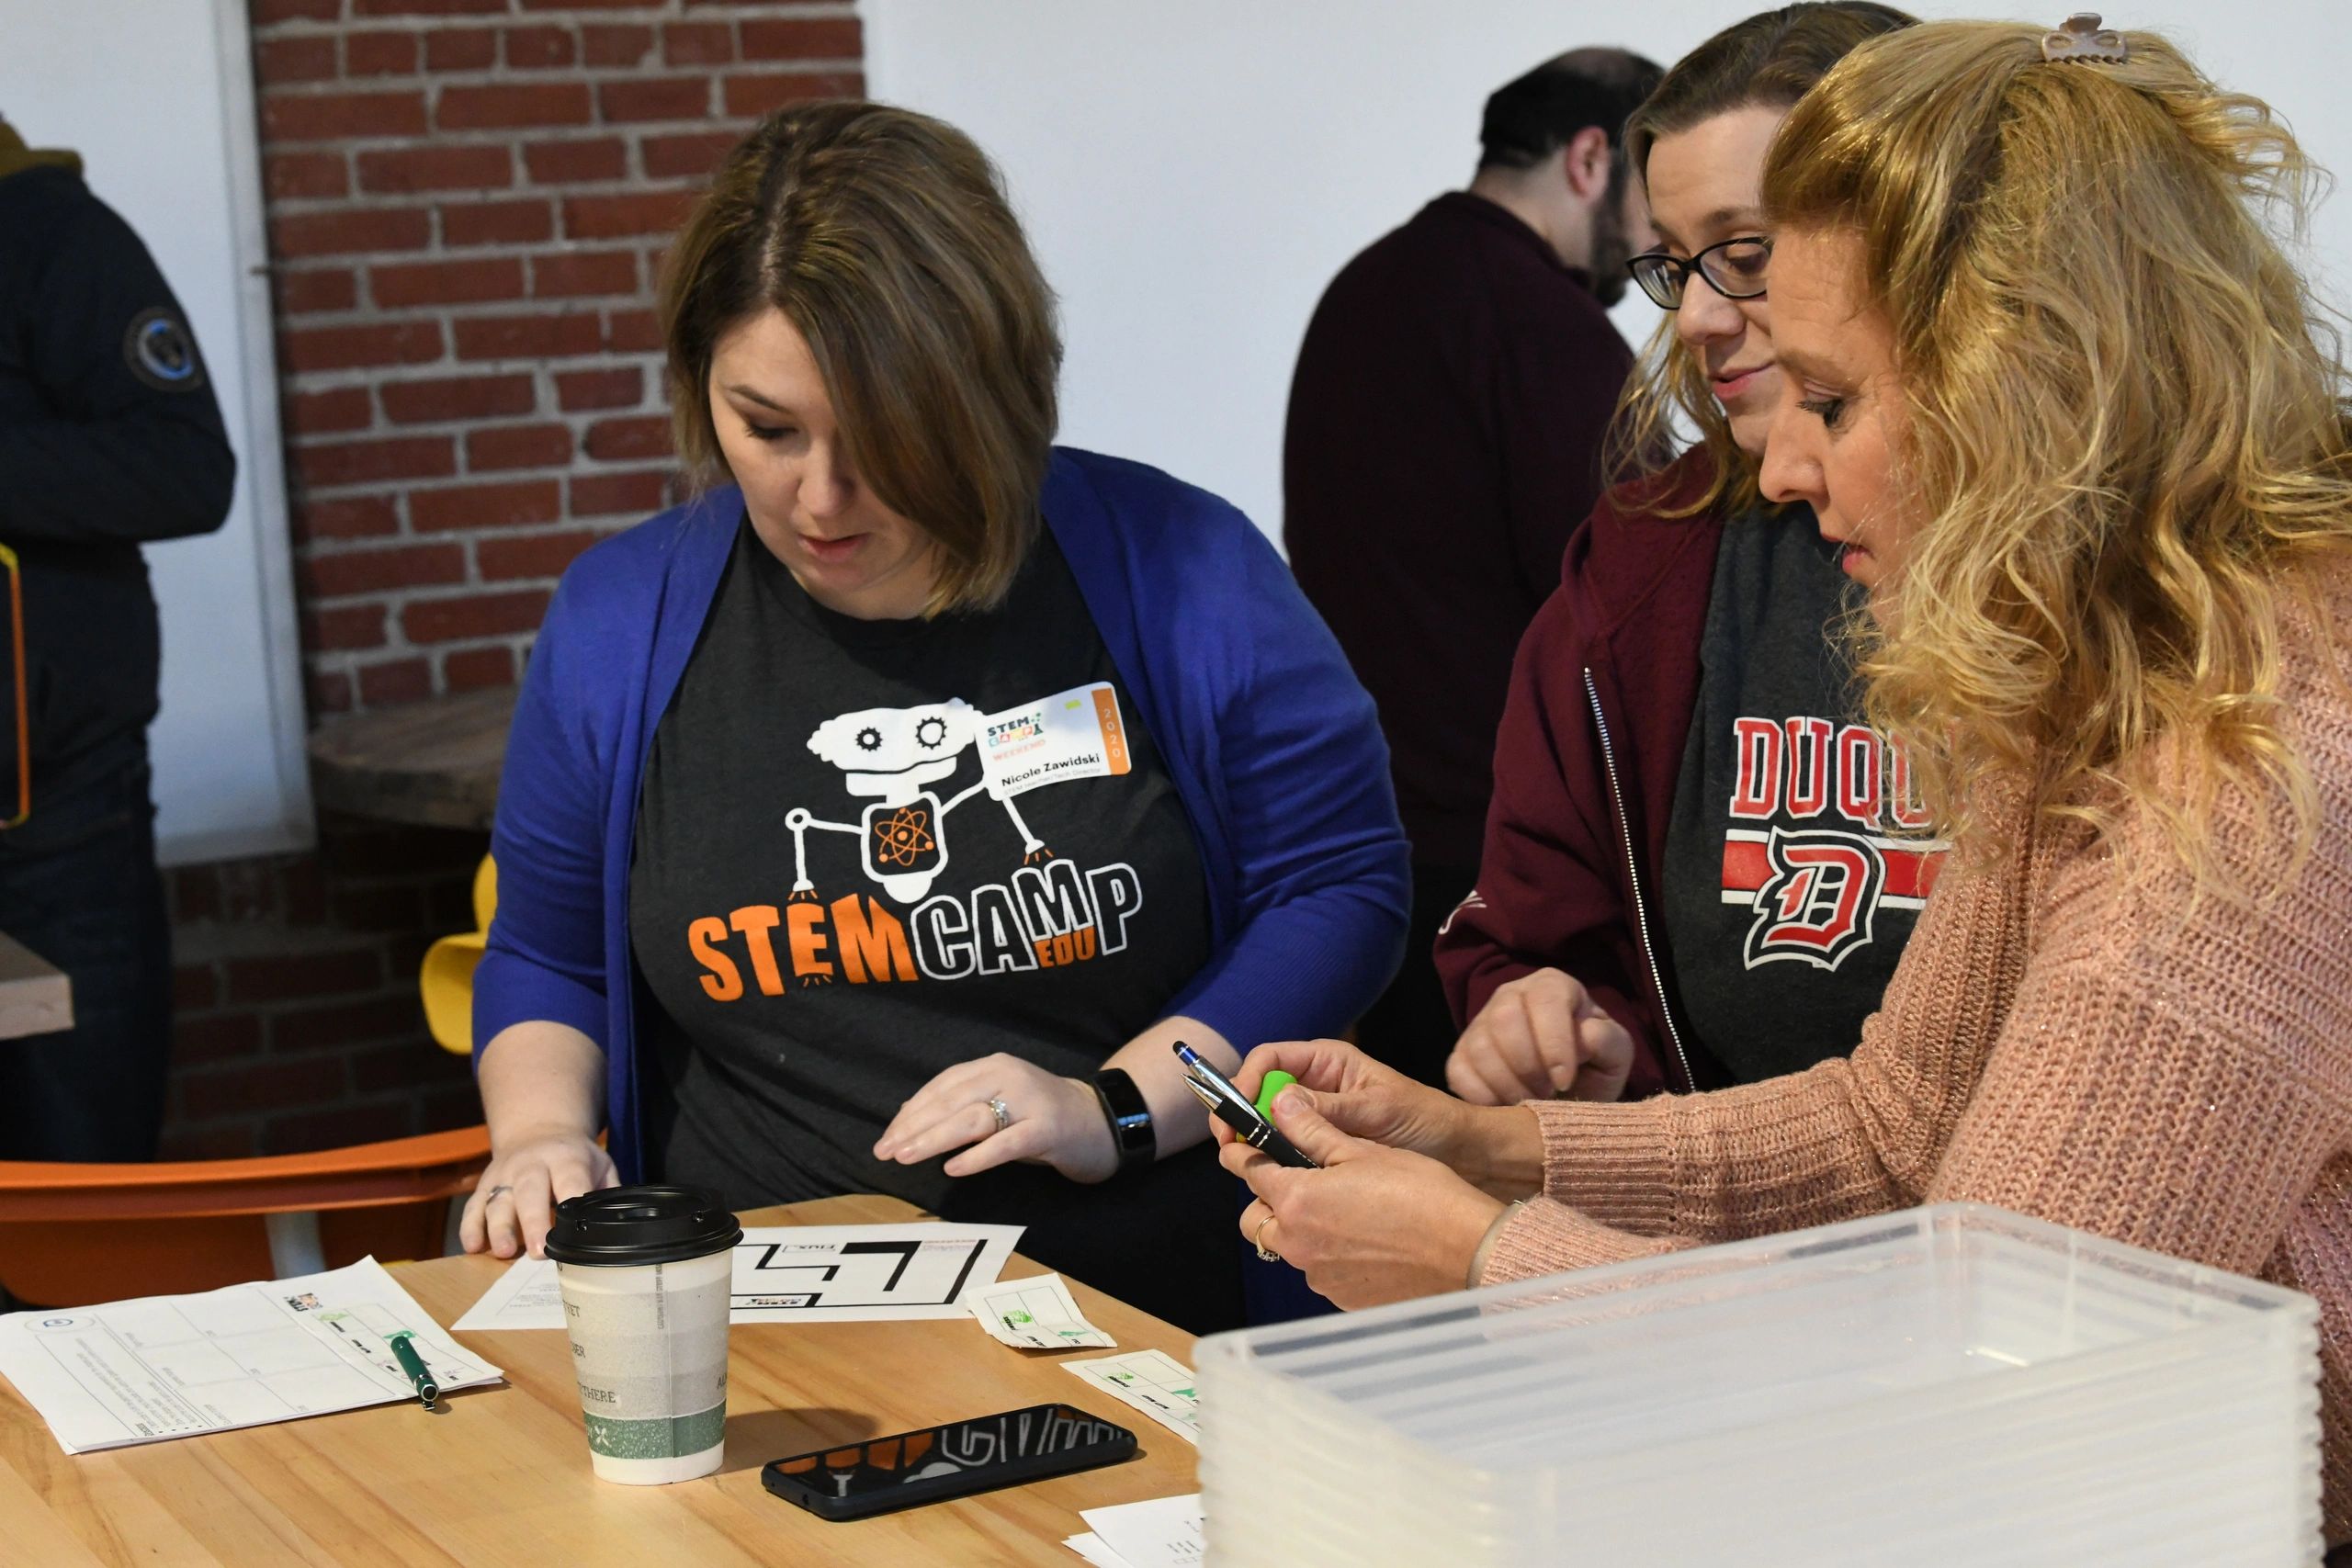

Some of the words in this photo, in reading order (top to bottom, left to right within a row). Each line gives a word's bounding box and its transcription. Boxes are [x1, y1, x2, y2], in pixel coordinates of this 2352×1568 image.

[987, 716, 1030, 738] STEM
[1103, 707, 1122, 759] 2020
[1001, 768, 1041, 787] Nicole
[1044, 753, 1101, 773] Zawidski
[1728, 716, 1935, 831] DUQU
[1033, 926, 1096, 968] EDU
